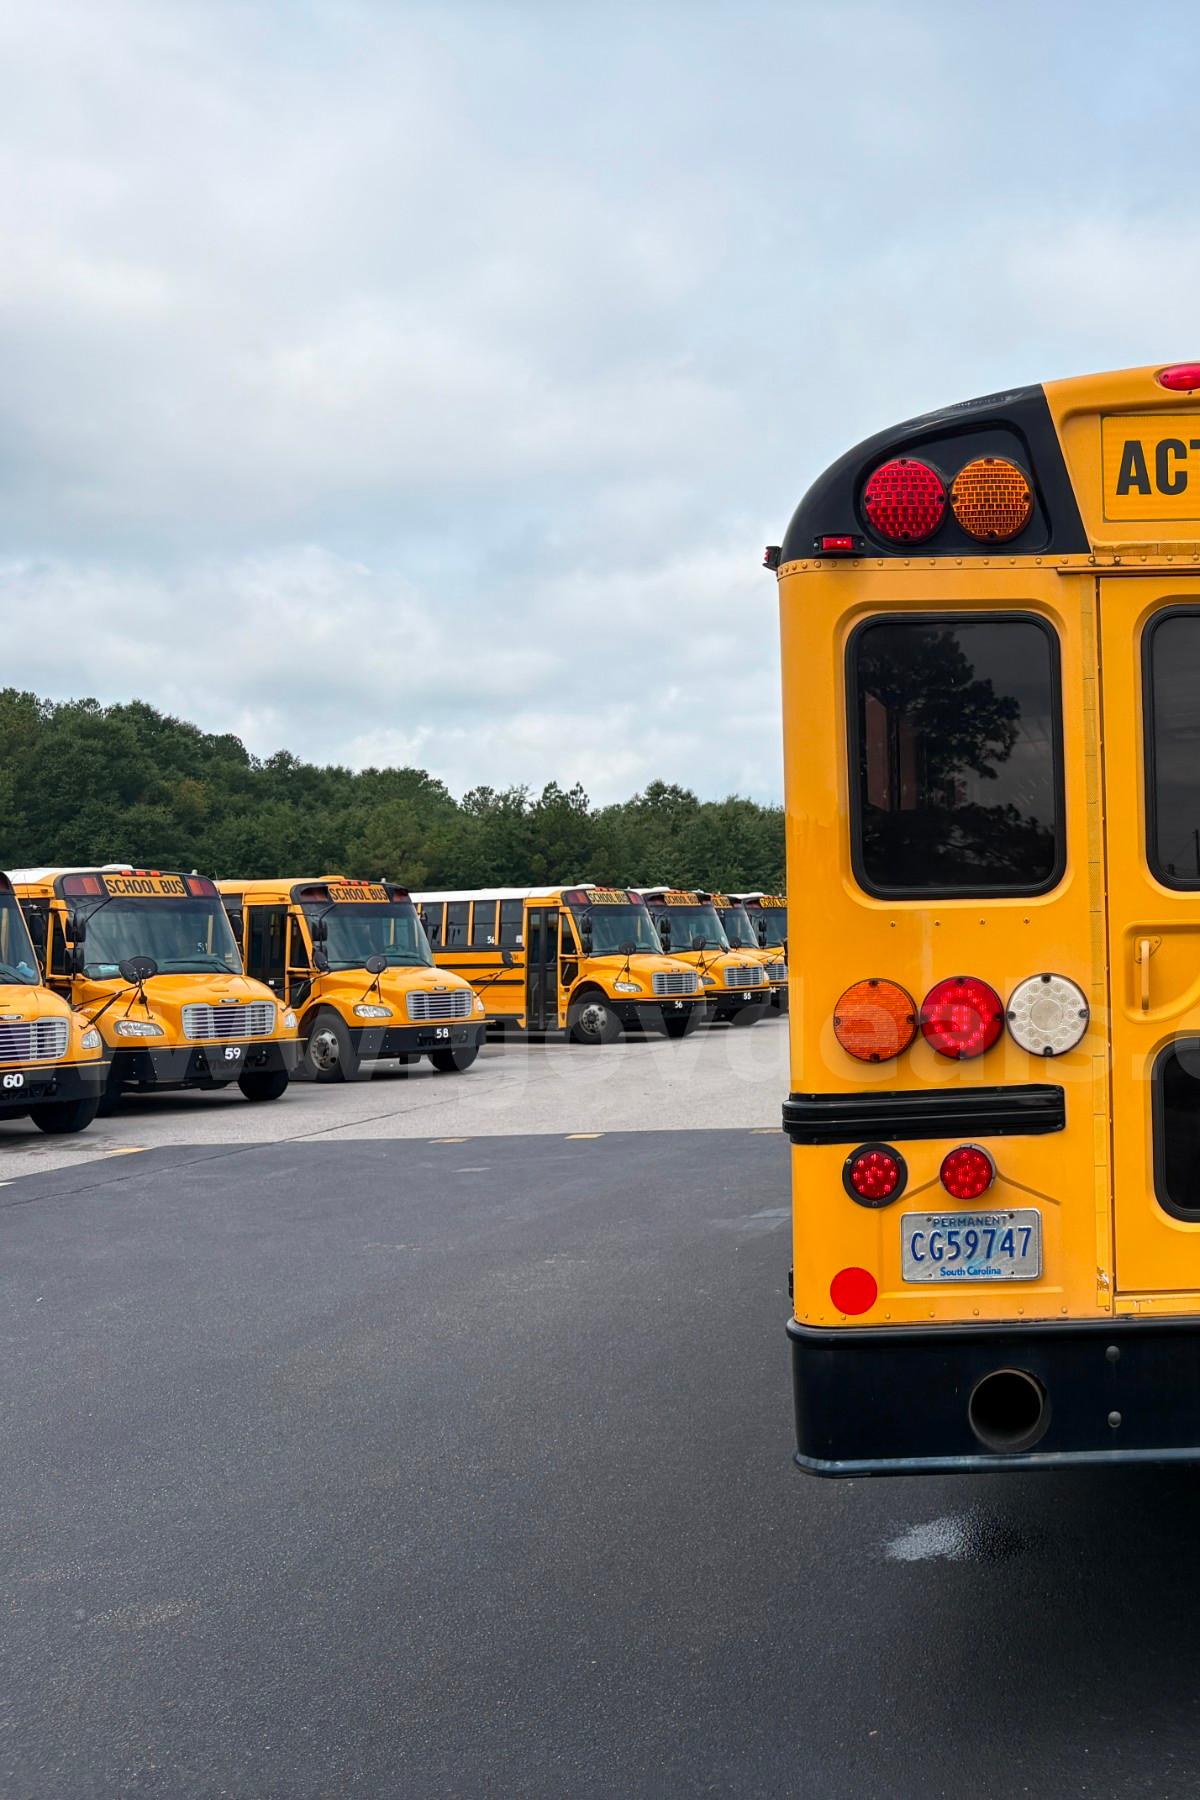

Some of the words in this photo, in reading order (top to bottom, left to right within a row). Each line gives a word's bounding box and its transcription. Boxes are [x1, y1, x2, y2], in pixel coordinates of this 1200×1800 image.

[105, 879, 160, 894] SCHOOL
[159, 880, 185, 894] BUS
[329, 888, 370, 900] SCHOOL
[368, 888, 388, 900] BUS
[674, 1000, 683, 1009] 56
[436, 1028, 449, 1039] 58
[224, 1047, 241, 1060] 59
[3, 1073, 24, 1088] 60
[932, 1215, 1008, 1228] PERMANENT
[911, 1226, 1032, 1262] CG59747
[940, 1266, 966, 1277] South
[967, 1265, 1002, 1276] Carolina
